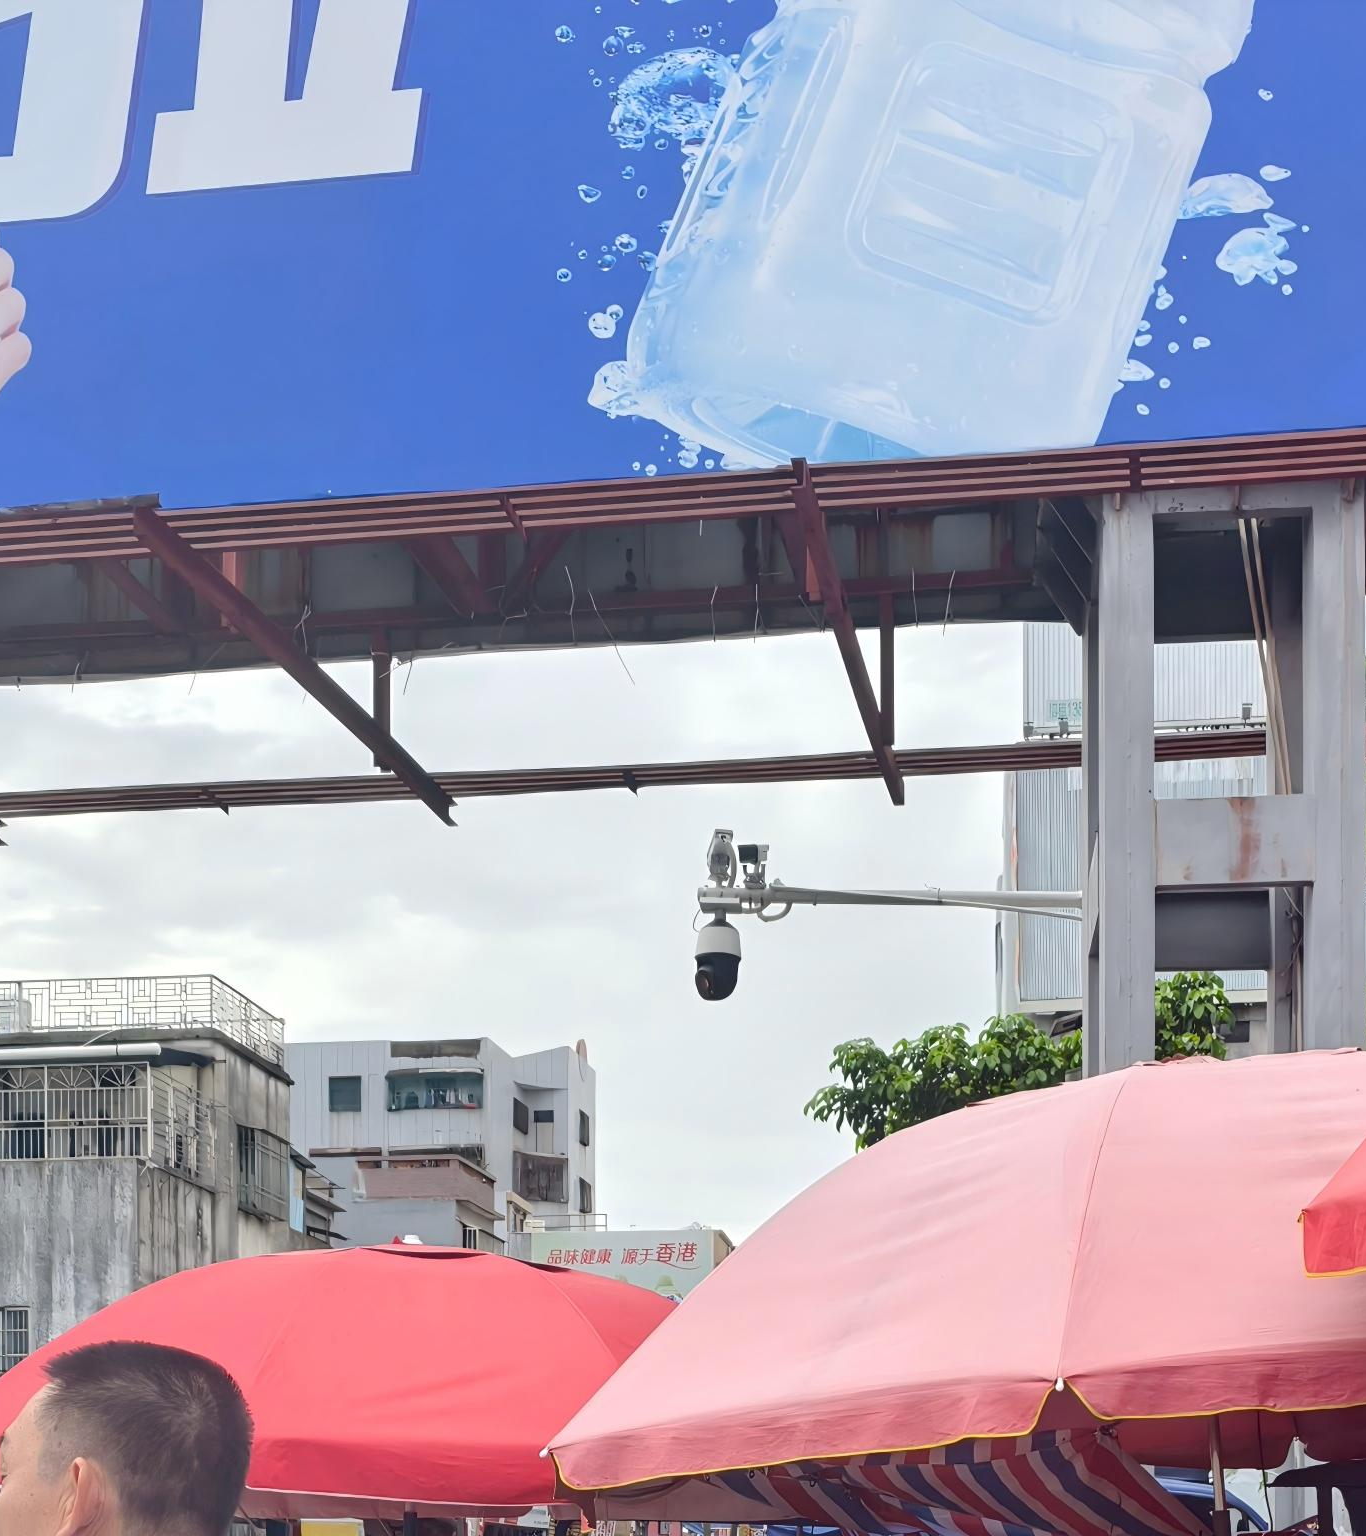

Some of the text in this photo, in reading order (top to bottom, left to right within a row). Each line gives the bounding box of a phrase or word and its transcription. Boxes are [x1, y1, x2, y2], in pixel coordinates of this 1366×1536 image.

[547, 1242, 698, 1266] 品味健康 源于香港
